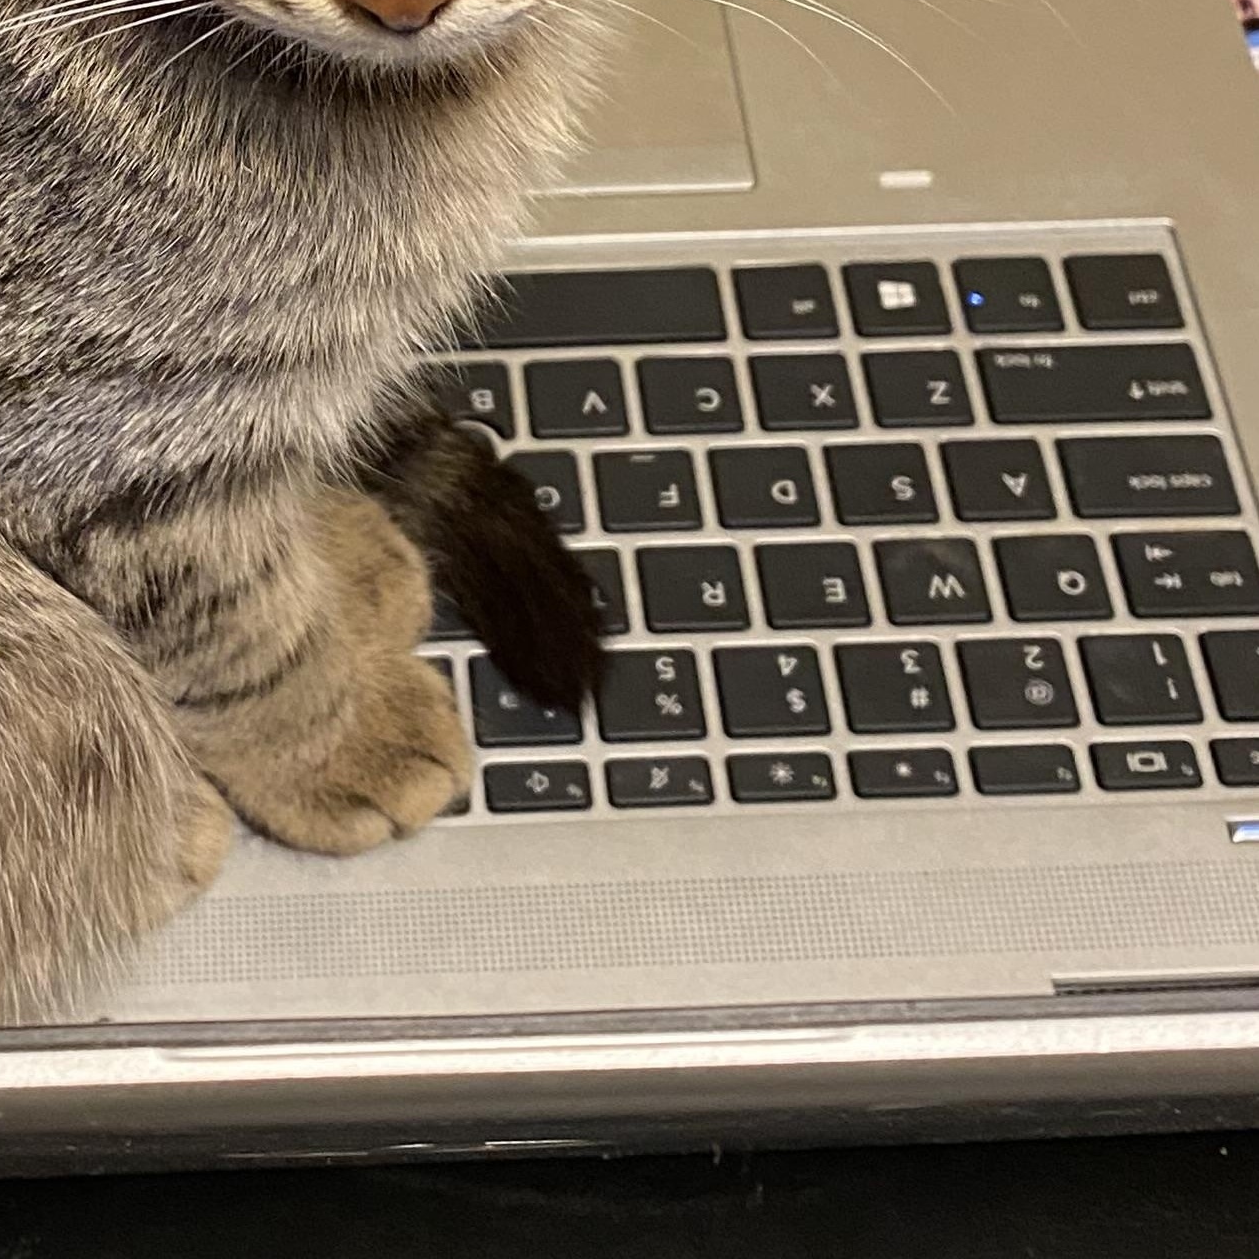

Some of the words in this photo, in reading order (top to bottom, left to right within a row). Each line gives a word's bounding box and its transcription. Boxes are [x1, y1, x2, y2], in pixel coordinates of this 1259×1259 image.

[471, 388, 496, 412] B
[582, 390, 607, 414] V
[695, 387, 721, 412] C
[811, 384, 836, 407] X
[926, 380, 951, 405] Z
[658, 483, 681, 508] F
[771, 479, 797, 505] D
[891, 475, 916, 501] S
[1002, 472, 1028, 498] A
[700, 581, 727, 607] R
[822, 577, 848, 604] E
[929, 573, 966, 600] W
[1056, 570, 1088, 596] Q
[777, 653, 799, 677] 4
[899, 648, 922, 674] 3
[1023, 644, 1045, 670] 2
[1151, 640, 1168, 665] 1
[655, 655, 676, 681] 5
[655, 692, 683, 716] %
[785, 687, 807, 714] $
[909, 686, 930, 709] #
[1024, 679, 1054, 706] @
